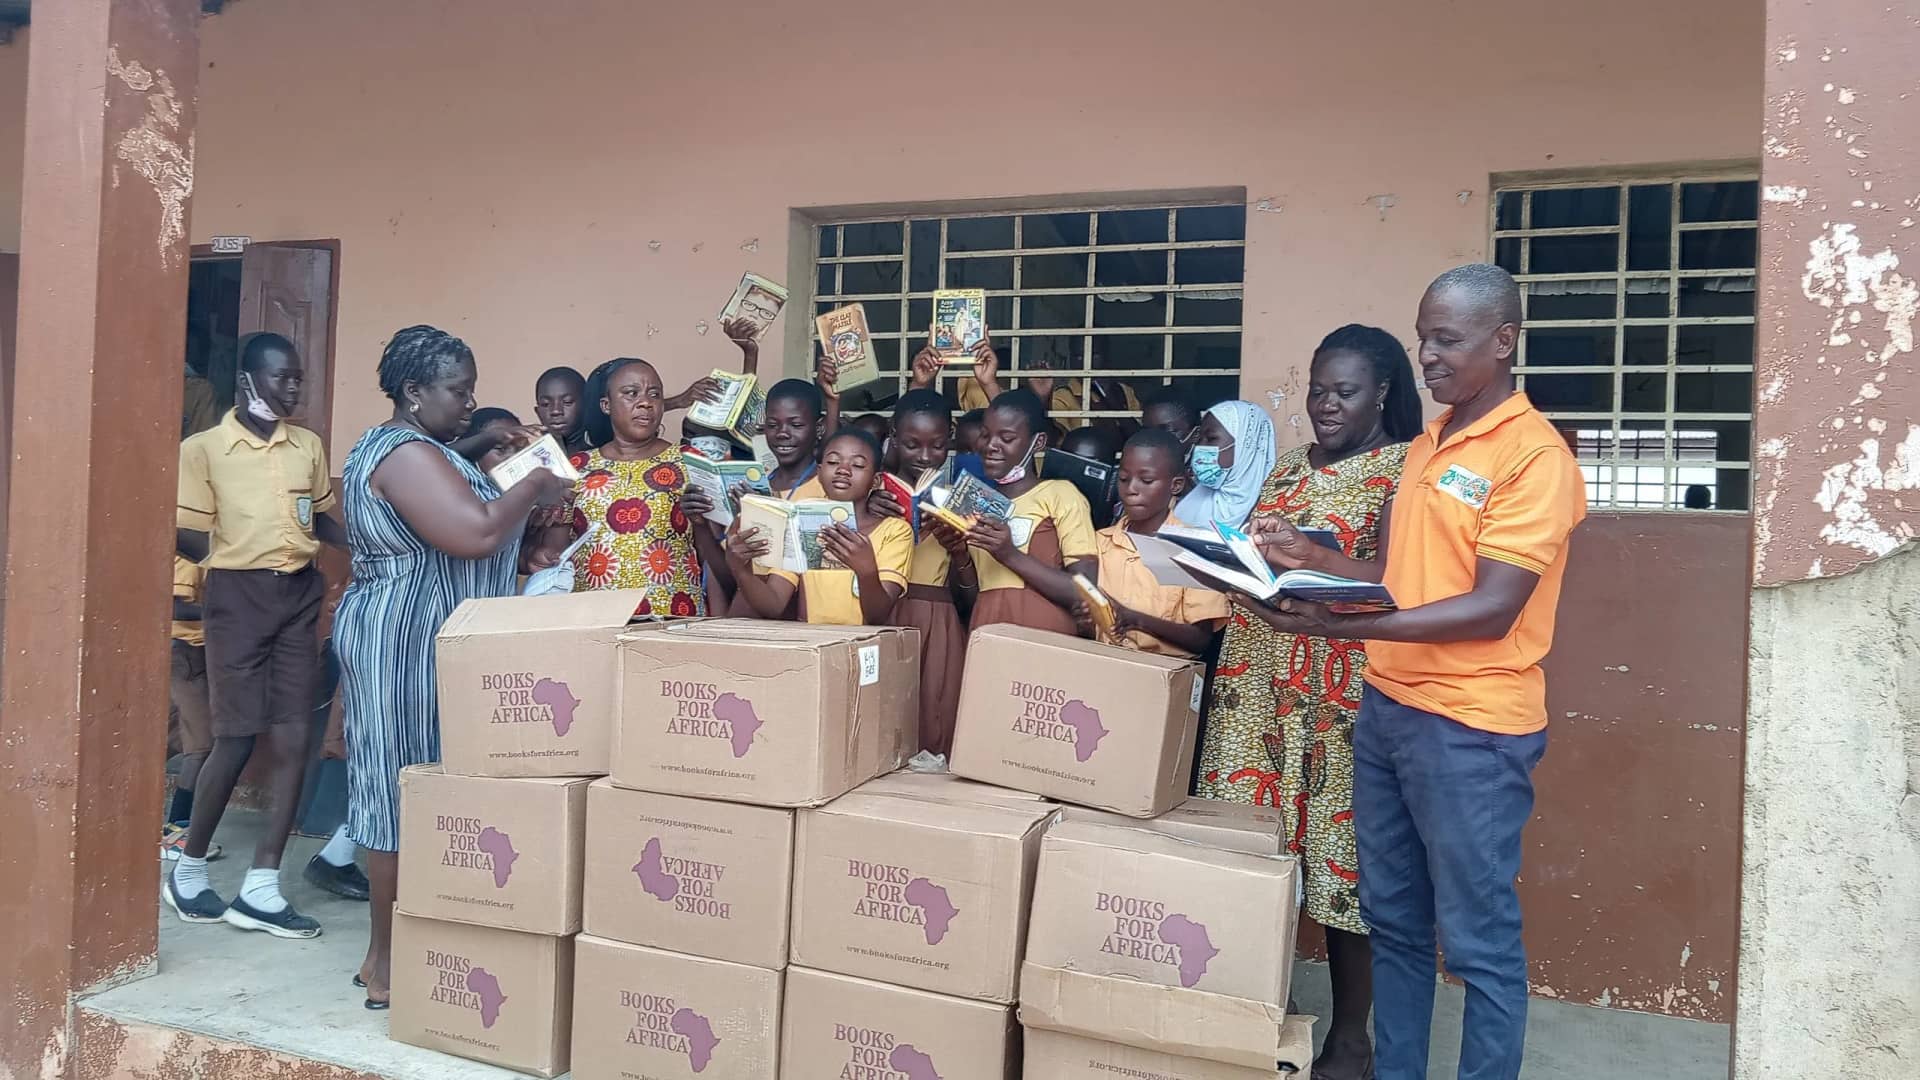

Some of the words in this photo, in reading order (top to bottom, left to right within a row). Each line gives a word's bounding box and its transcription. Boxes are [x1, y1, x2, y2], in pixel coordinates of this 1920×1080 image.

[482, 672, 534, 690] BOOKS
[660, 680, 717, 701] BOOKS
[498, 690, 530, 707] FOR
[1010, 681, 1066, 706] BOOKS
[490, 706, 552, 724] AFRICA
[677, 700, 710, 719] FOR
[1024, 701, 1057, 722] FOR
[666, 718, 730, 739] AFRICA
[1011, 716, 1074, 743] AFRICA
[437, 815, 481, 835] BOOKS
[449, 834, 476, 851] FOR
[441, 849, 493, 870] AFRICA
[662, 856, 727, 882] AFRICA
[848, 859, 909, 885] BOOKS
[681, 877, 715, 898] FOR
[865, 881, 902, 903] FOR
[674, 894, 732, 919] BOOKS
[853, 898, 923, 925] AFRICA
[1096, 892, 1164, 921] BOOKS
[1114, 917, 1155, 941] FOR
[426, 950, 470, 974] BOOKS
[1100, 935, 1178, 966] AFRICA
[439, 970, 465, 990] FOR
[430, 986, 480, 1010] AFRICA
[620, 990, 675, 1015] BOOKS
[637, 1011, 669, 1032] FOR
[626, 1027, 689, 1054] AFRICA
[833, 1023, 894, 1051] BOOKS
[851, 1045, 887, 1069] FOR
